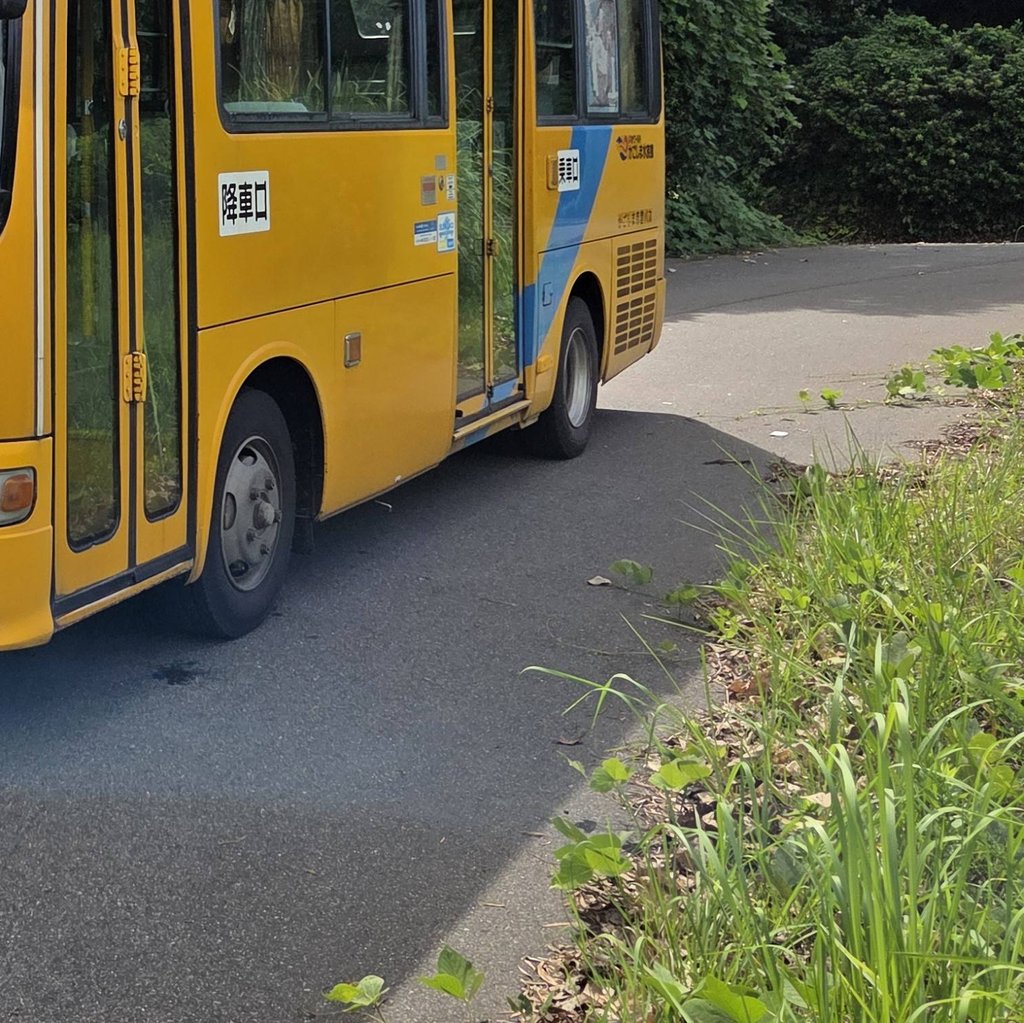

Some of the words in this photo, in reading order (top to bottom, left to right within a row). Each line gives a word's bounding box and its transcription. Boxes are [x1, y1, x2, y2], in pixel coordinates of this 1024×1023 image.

[559, 157, 578, 184] 乗車口
[222, 180, 267, 226] 降車口
